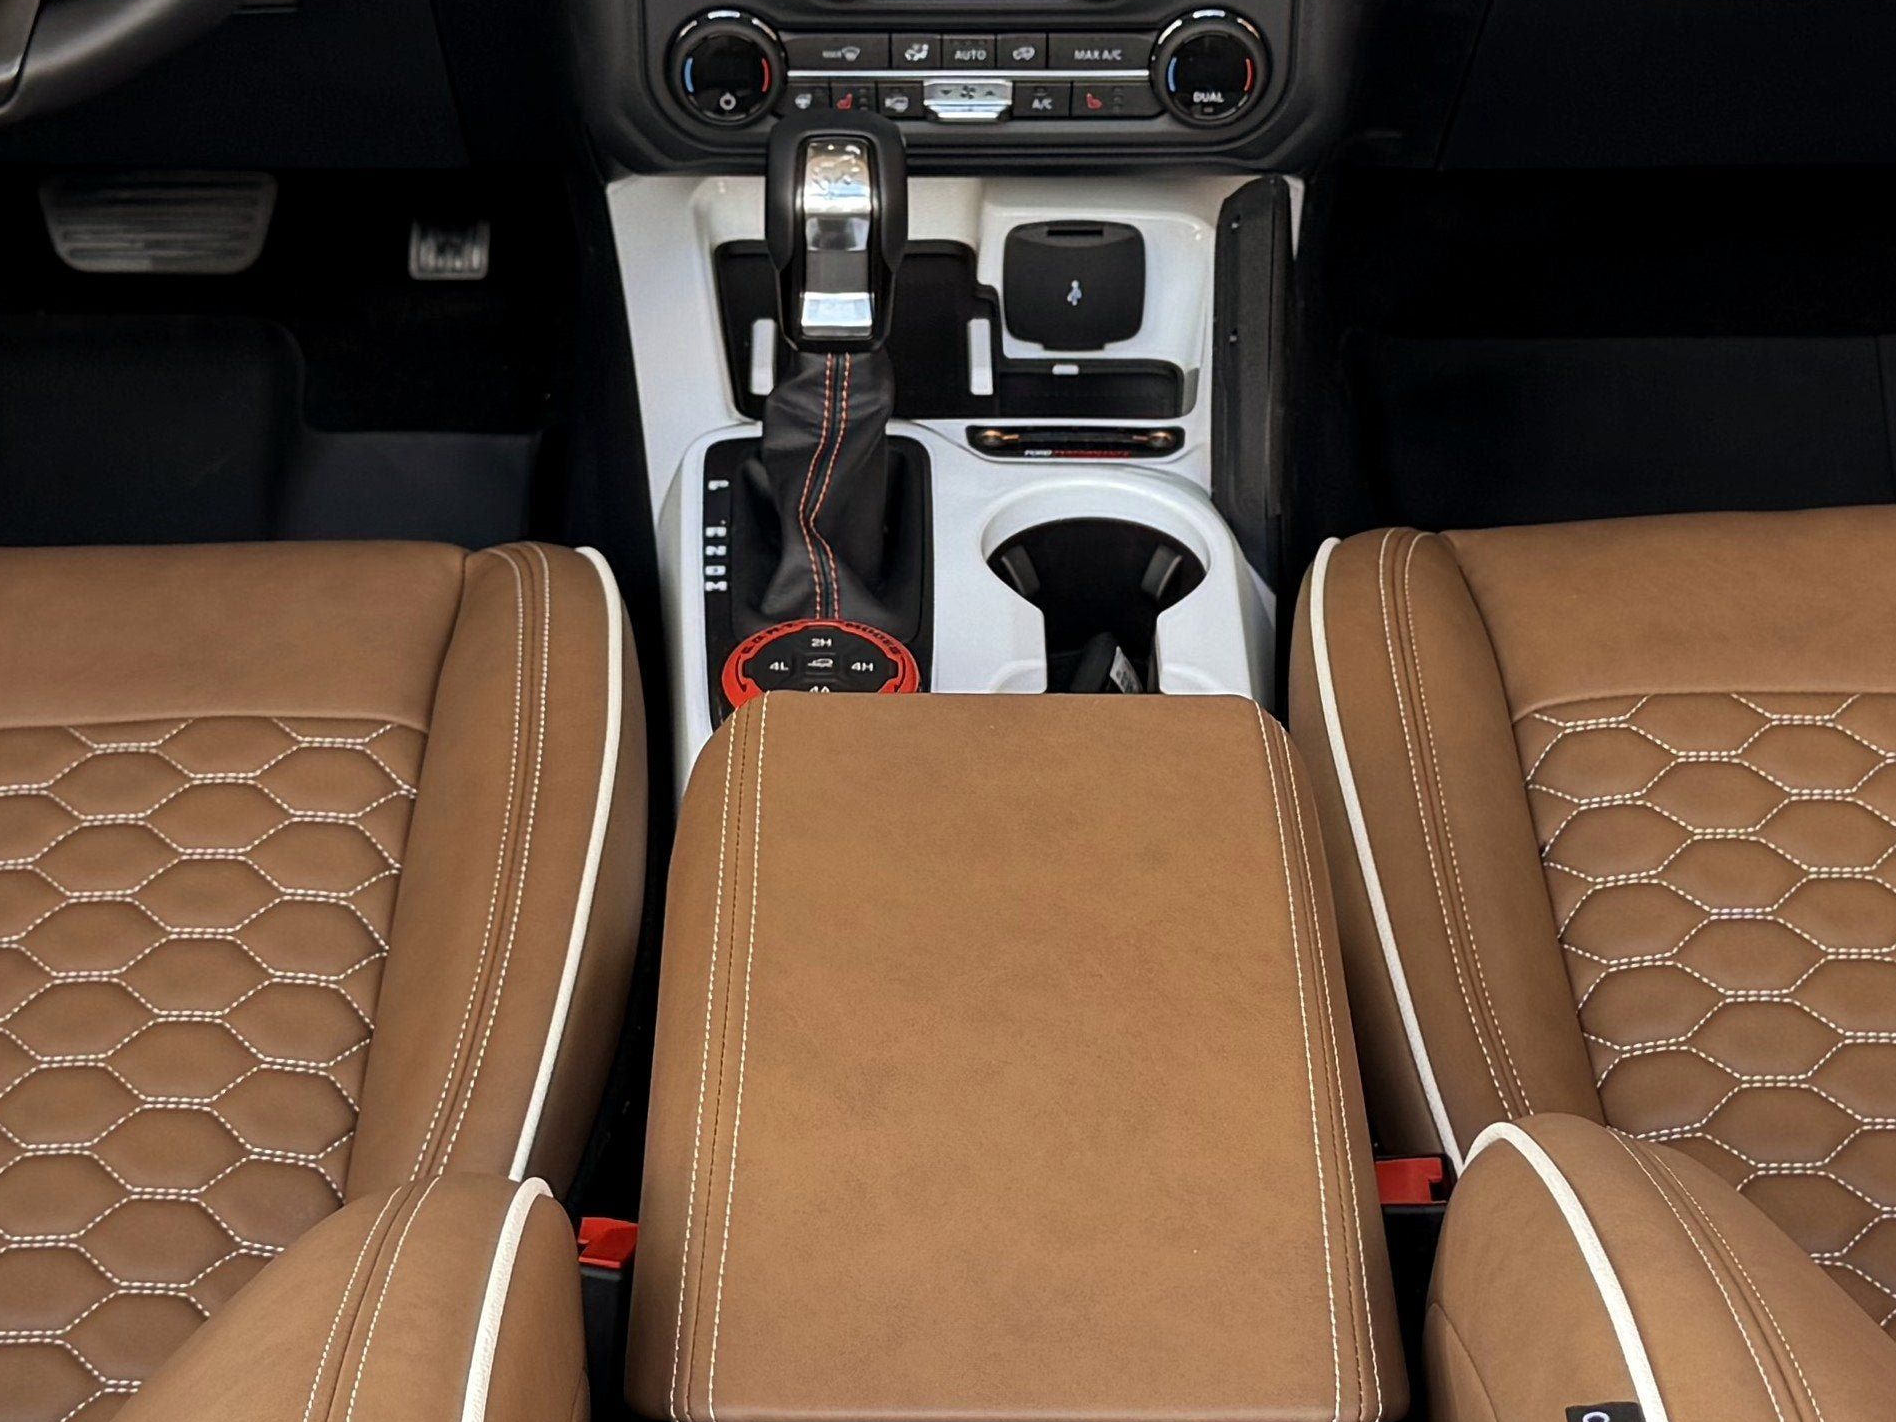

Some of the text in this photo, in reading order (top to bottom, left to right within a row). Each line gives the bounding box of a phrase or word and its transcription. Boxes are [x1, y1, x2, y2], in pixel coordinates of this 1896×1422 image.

[954, 50, 987, 62] AUTO
[1074, 50, 1123, 62] MAX A/C
[1193, 89, 1225, 104] DUAL
[1031, 98, 1053, 111] A/C
[707, 480, 730, 491] P
[705, 526, 727, 538] R
[705, 545, 727, 556] N
[705, 580, 728, 592] M
[810, 637, 833, 648] 2H
[768, 661, 790, 672] 4L
[850, 661, 875, 673] 4H
